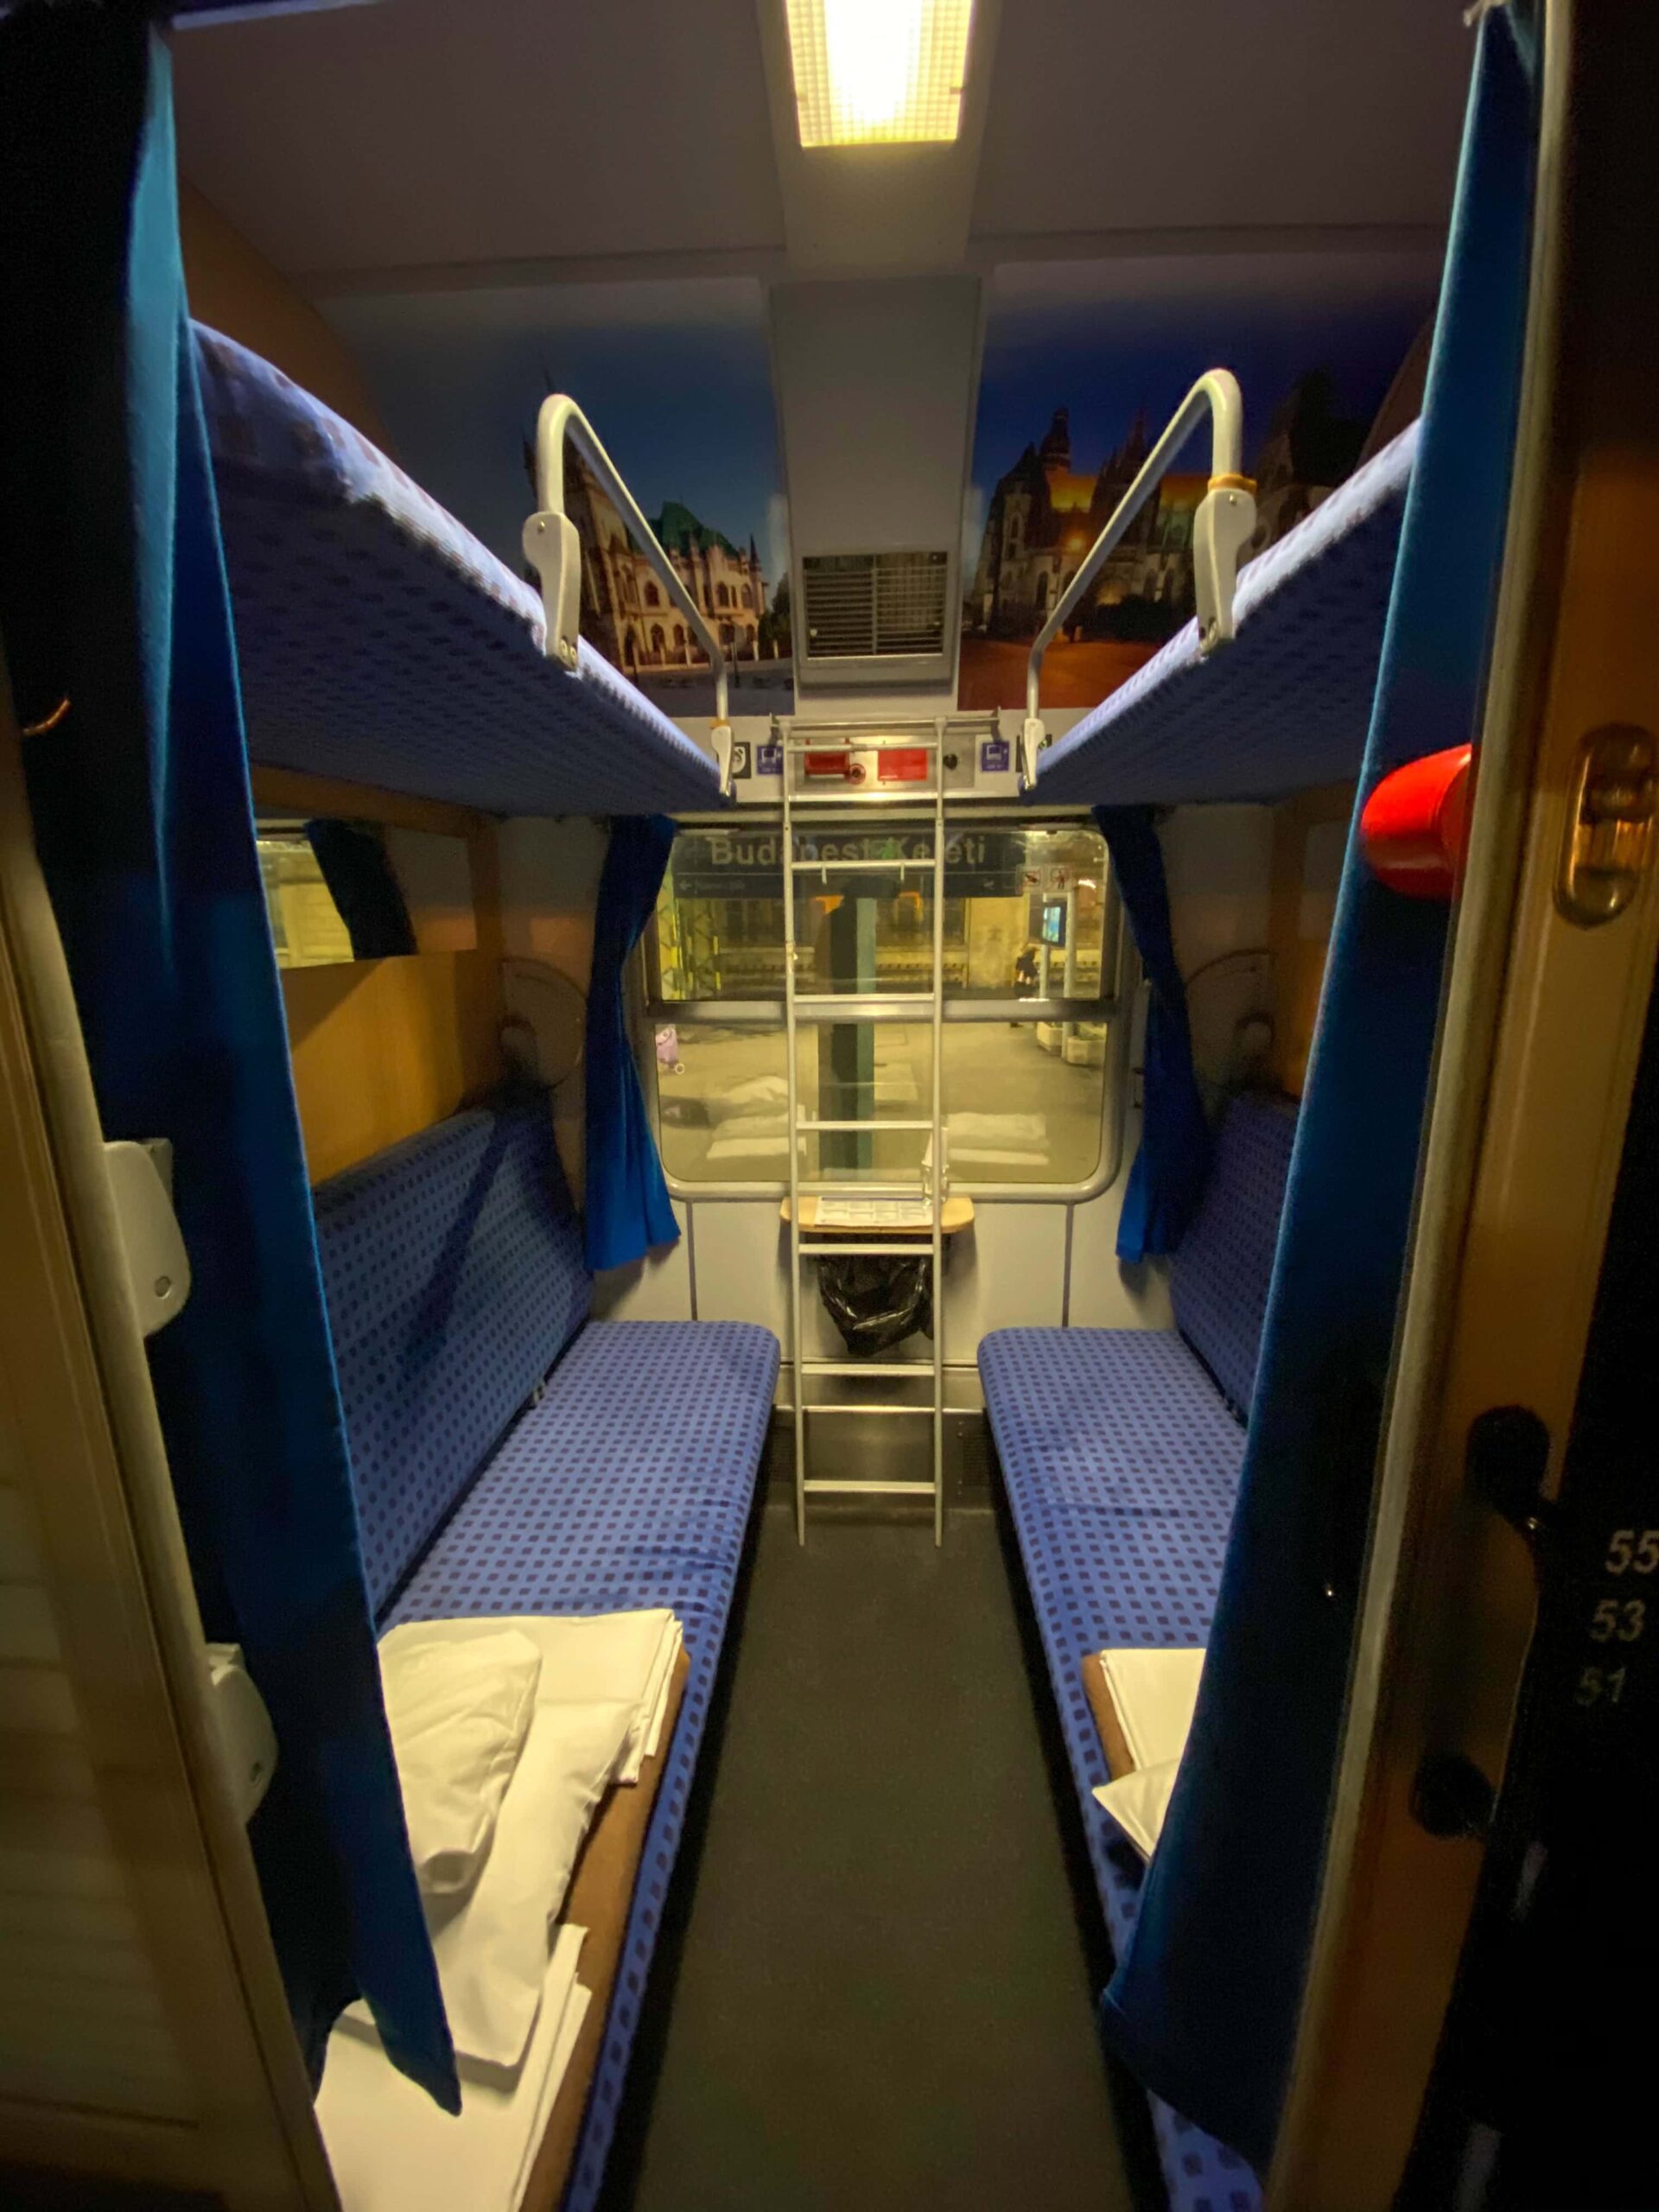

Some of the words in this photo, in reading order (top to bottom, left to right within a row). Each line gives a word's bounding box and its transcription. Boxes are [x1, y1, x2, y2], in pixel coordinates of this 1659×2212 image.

[886, 835, 986, 865] Keeti
[1605, 1529, 1659, 1573] 55
[1590, 1599, 1645, 1642] 53
